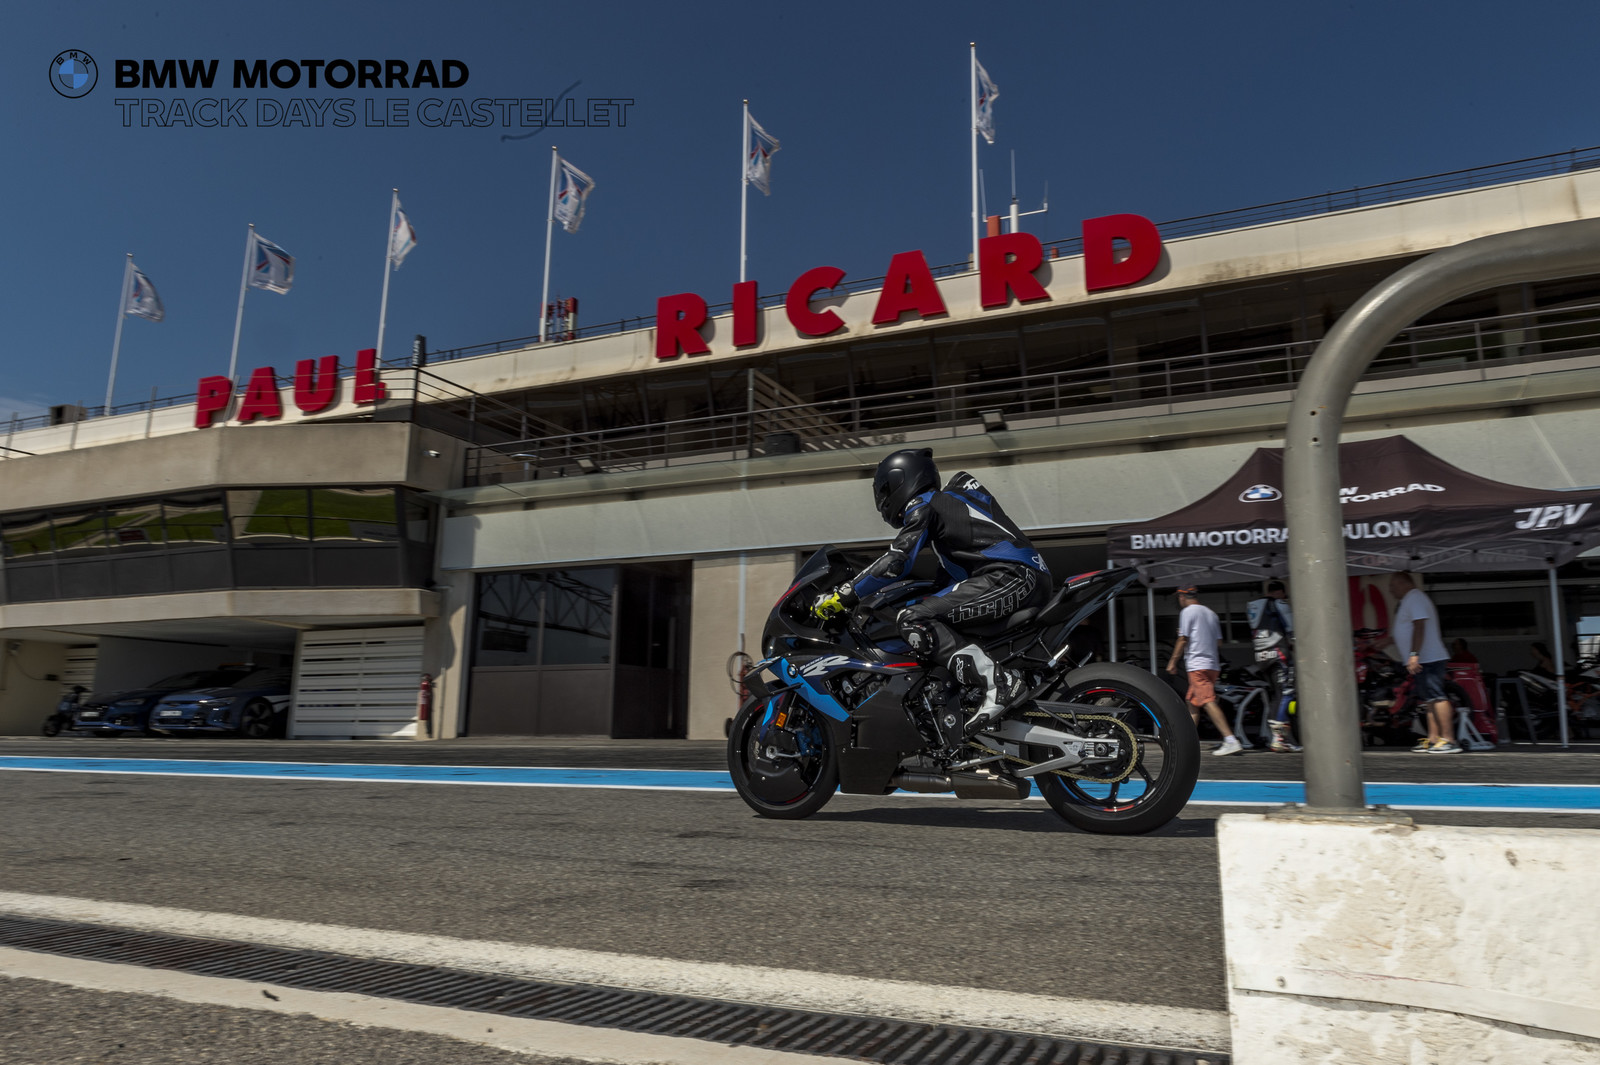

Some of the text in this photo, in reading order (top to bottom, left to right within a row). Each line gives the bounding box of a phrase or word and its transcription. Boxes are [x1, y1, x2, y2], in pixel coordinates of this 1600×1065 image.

[195, 213, 1163, 429] PAUL RICARD
[1339, 483, 1446, 503] TORRAD
[1514, 503, 1592, 530] JPV
[1130, 520, 1412, 550] BMW MOTORRA ULON
